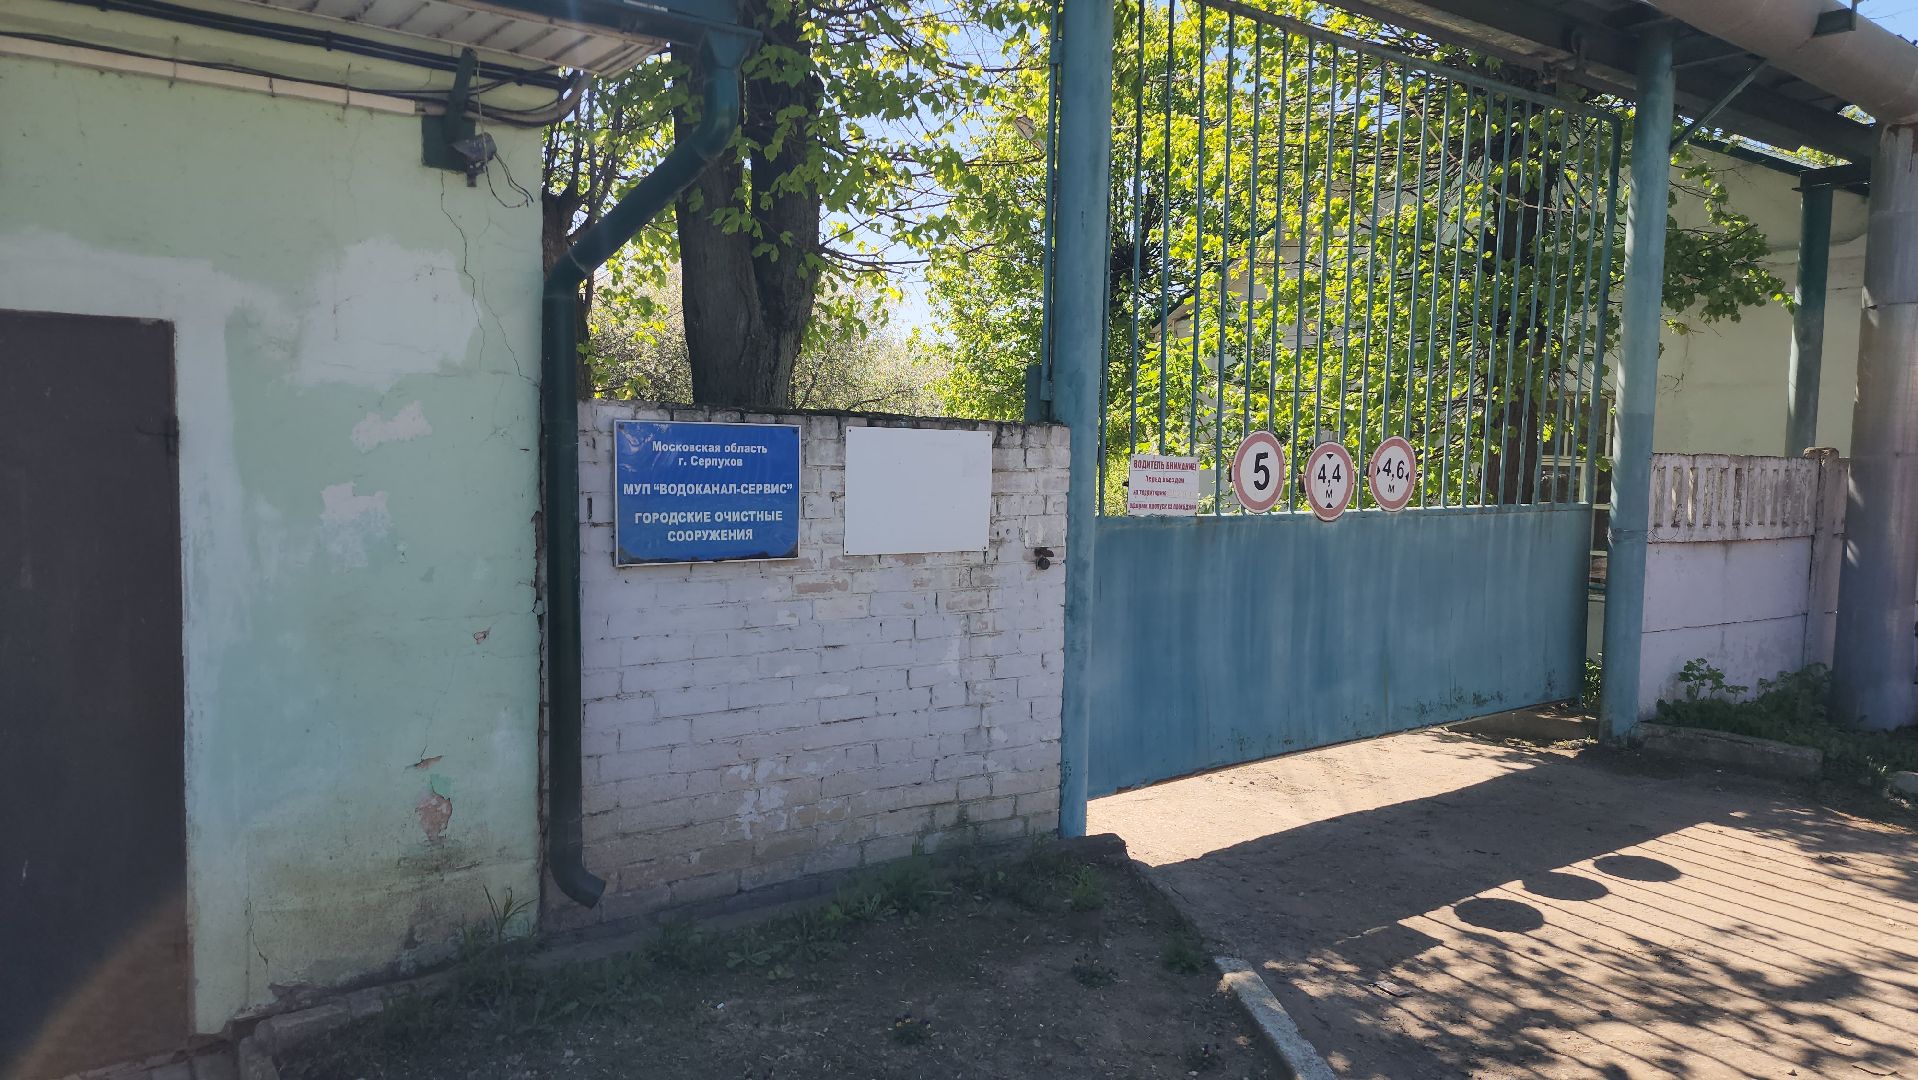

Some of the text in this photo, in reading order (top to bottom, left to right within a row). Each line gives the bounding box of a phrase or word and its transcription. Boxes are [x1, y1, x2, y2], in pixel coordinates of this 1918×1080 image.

[652, 441, 768, 453] Московская область
[678, 456, 743, 469] г. Серпухов
[1133, 460, 1165, 470] ВОДИТЕЛЬ
[1382, 457, 1405, 481] 4,6
[1253, 451, 1270, 491] 5
[1317, 463, 1342, 487] 4,4
[623, 483, 650, 495] МУП
[634, 510, 783, 525] ГОРОДСКИЕ ОЧИСТНЫЕ
[667, 528, 753, 542] СООРУЖЕНИЯ
